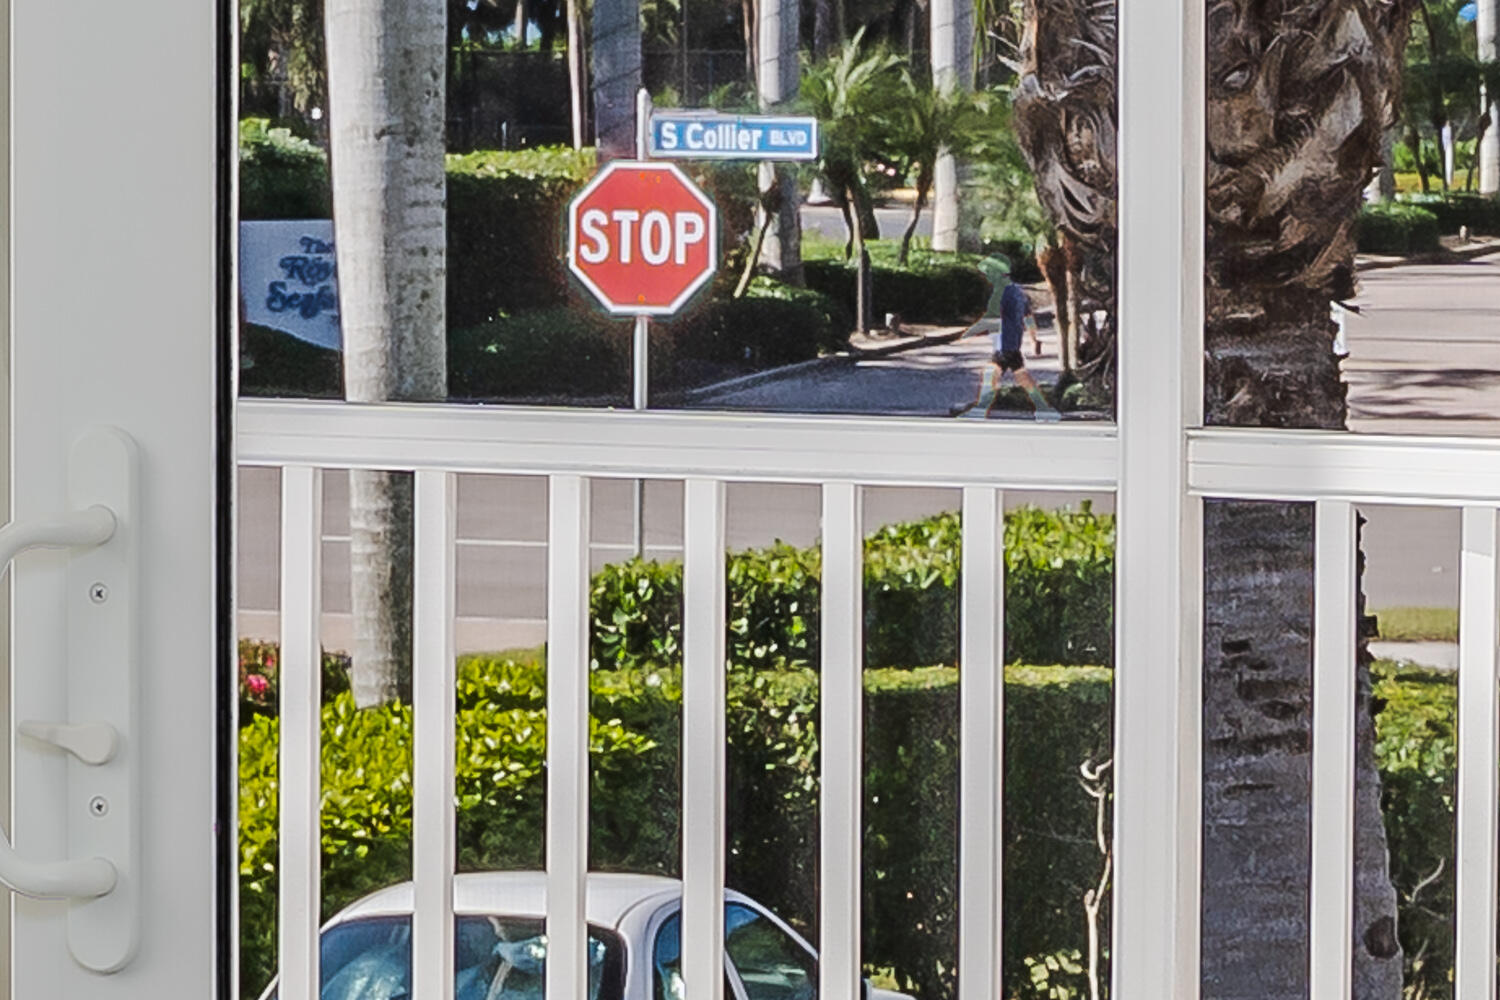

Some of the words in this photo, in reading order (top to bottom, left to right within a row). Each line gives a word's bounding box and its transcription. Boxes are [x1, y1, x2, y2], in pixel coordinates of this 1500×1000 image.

[661, 122, 677, 149] S
[686, 123, 762, 150] Collier
[769, 130, 807, 146] BLVD
[580, 209, 705, 265] STOP
